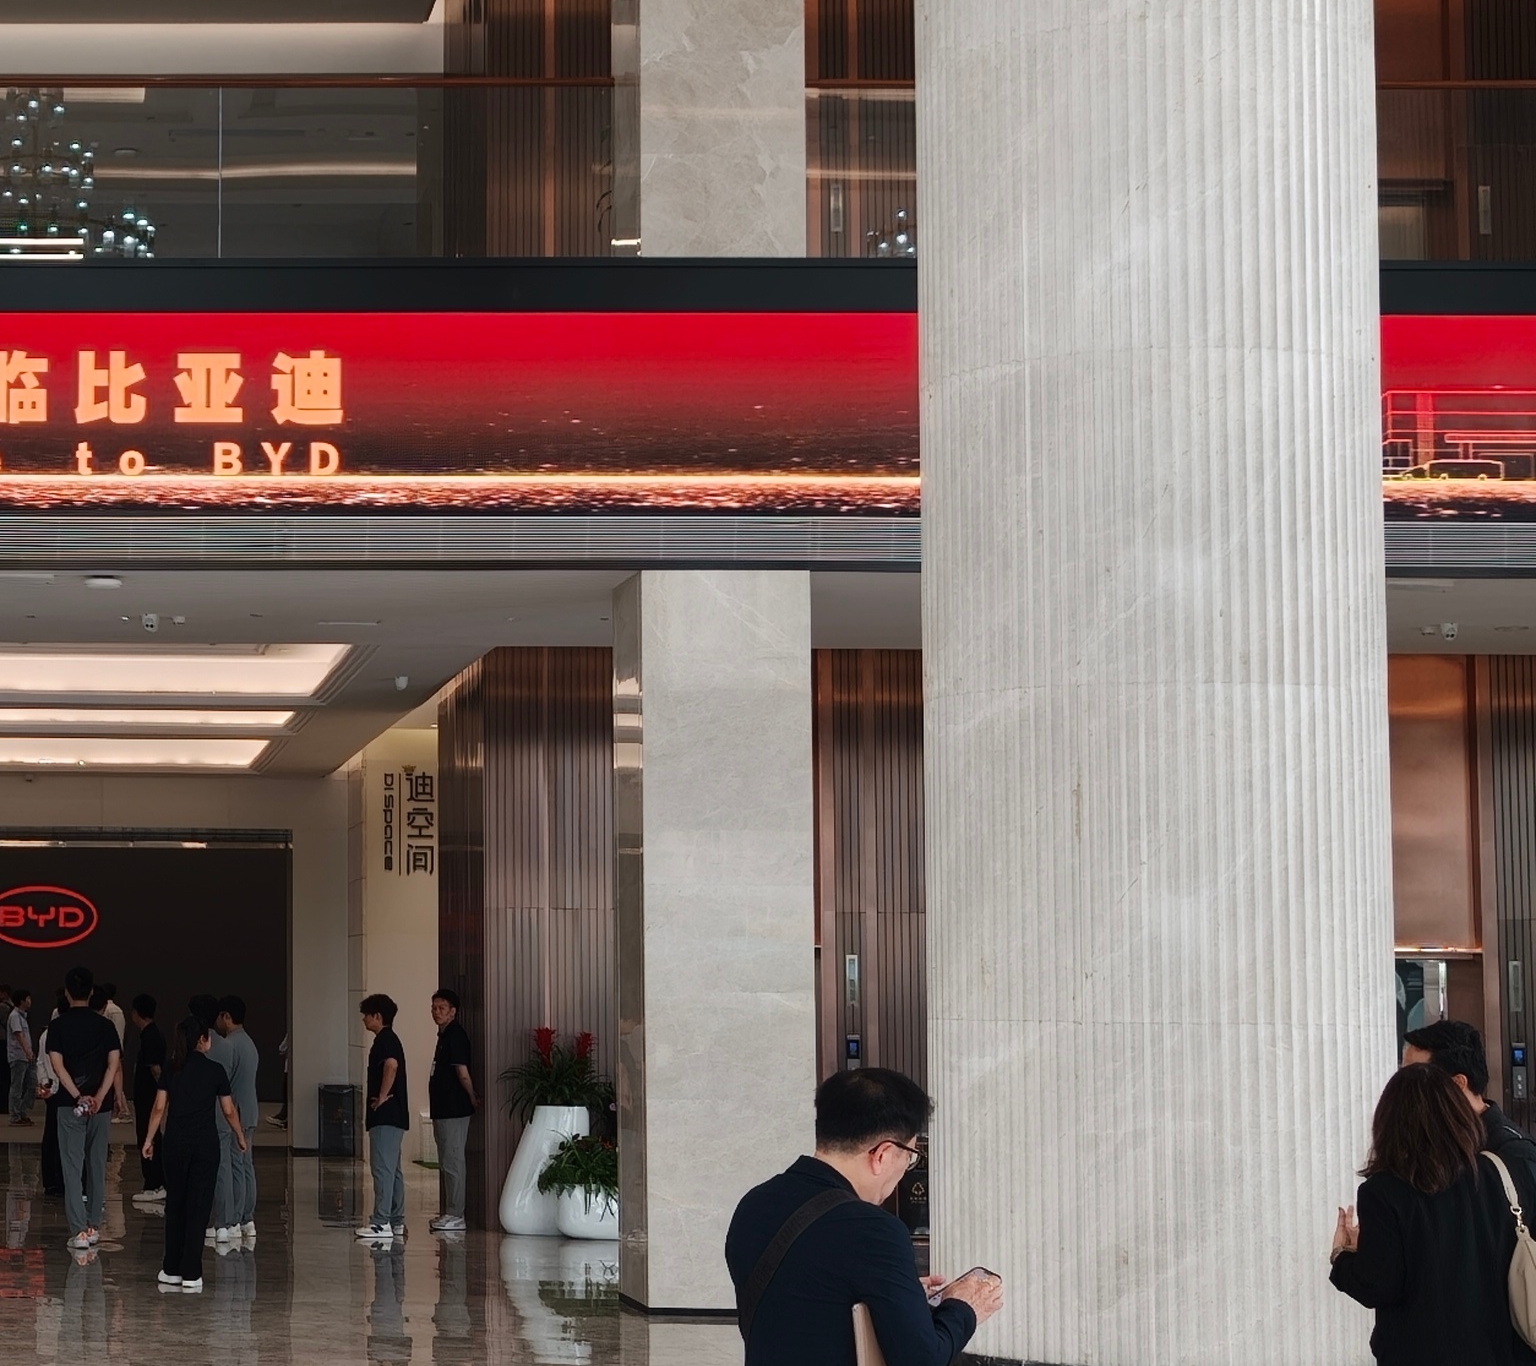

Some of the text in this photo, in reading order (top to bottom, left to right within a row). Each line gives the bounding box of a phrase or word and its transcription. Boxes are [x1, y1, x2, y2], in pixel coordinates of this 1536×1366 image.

[75, 442, 146, 476] to
[213, 442, 340, 476] BYD
[405, 771, 436, 876] 迪空间
